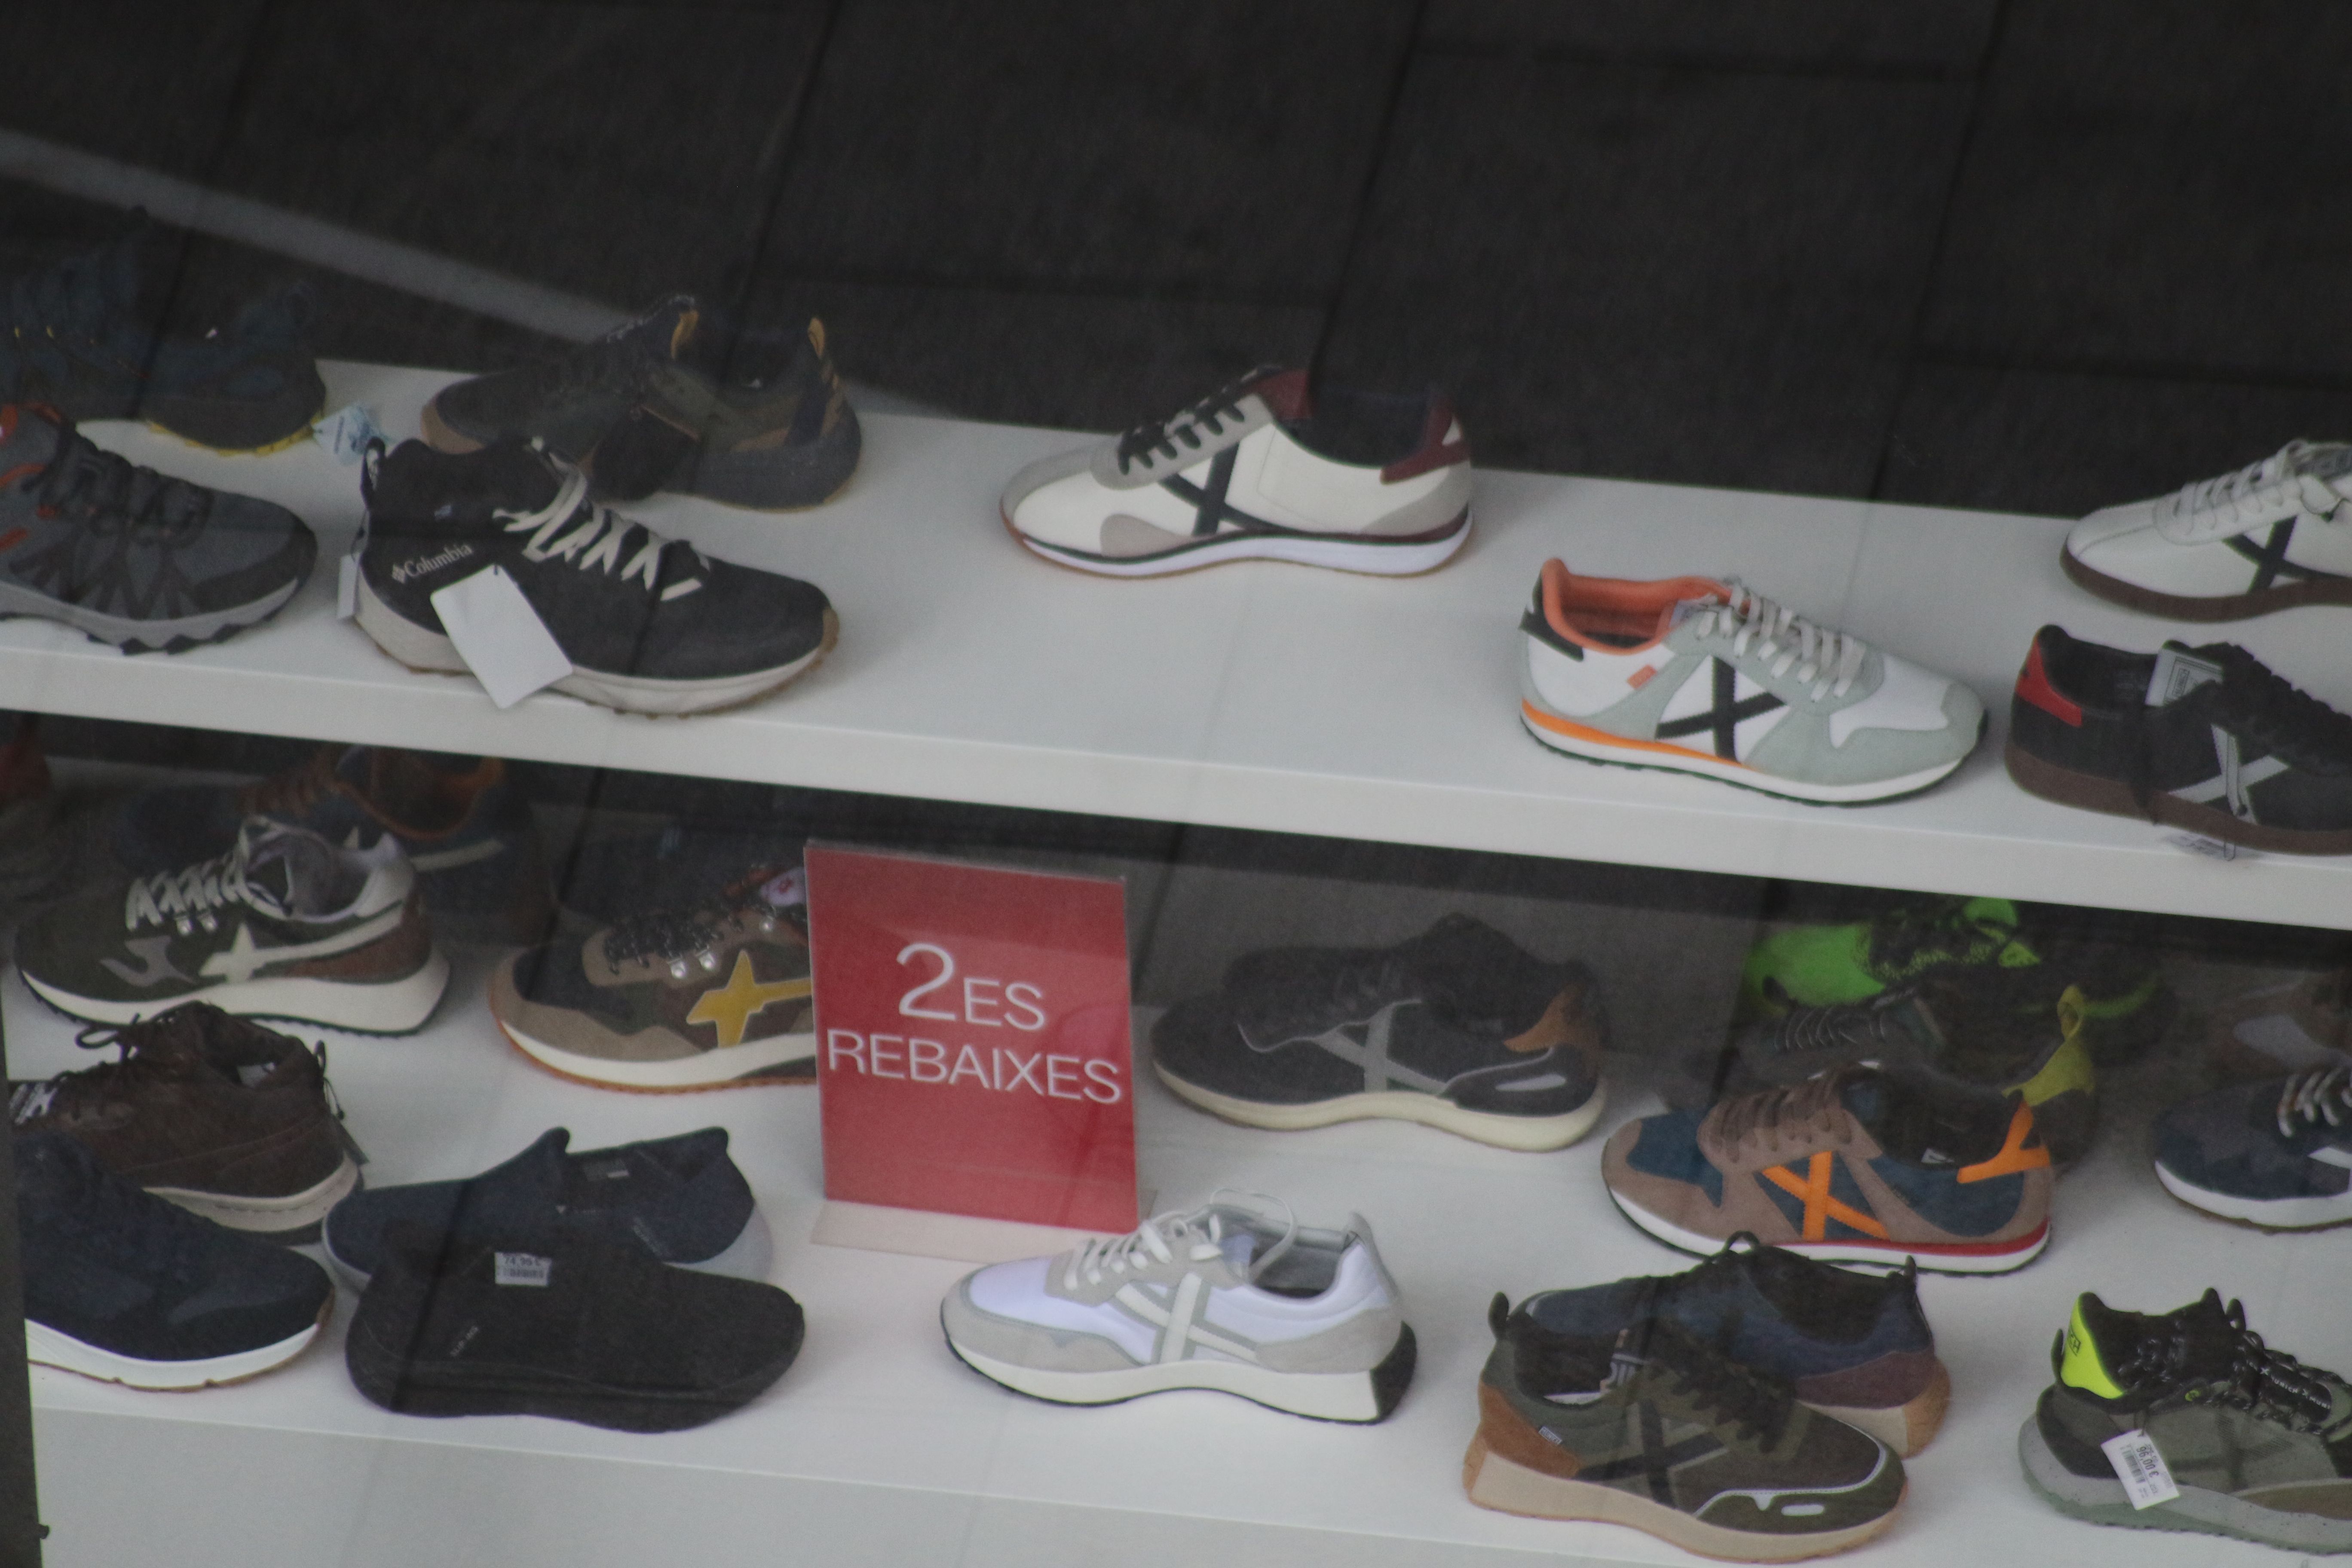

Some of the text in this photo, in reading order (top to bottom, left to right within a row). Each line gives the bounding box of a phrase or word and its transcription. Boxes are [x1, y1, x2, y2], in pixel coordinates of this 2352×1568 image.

[404, 543, 473, 578] Columbia
[896, 942, 1047, 1032] 2ES
[827, 1027, 1123, 1105] REBAIXES
[2136, 1446, 2156, 1470] 96,00
[2149, 1470, 2159, 1478] €
